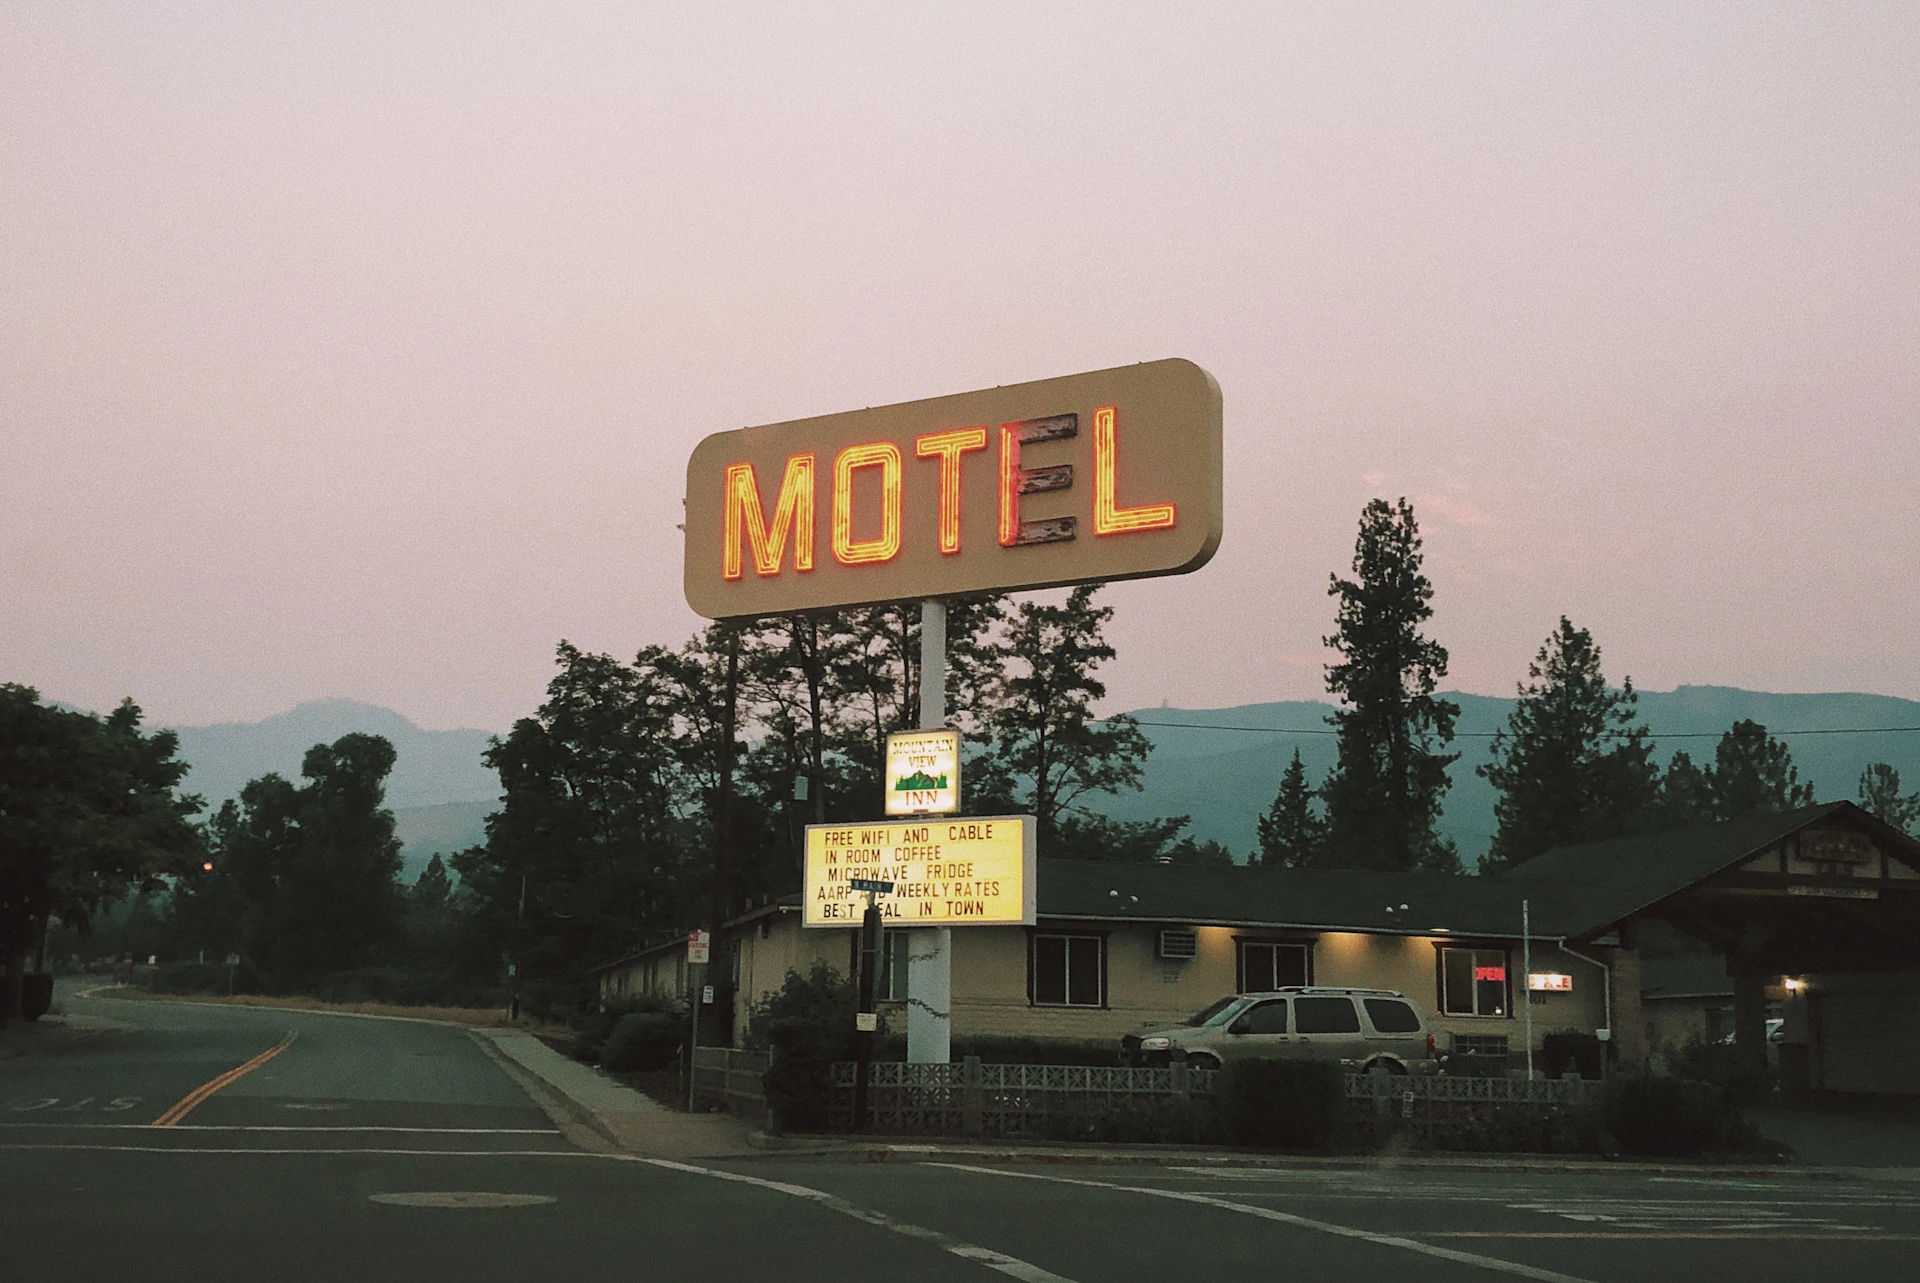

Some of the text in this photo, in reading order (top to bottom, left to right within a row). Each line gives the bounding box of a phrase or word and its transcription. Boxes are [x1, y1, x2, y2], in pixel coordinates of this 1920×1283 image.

[722, 406, 1176, 580] MOTEL
[893, 739, 953, 754] MOUNTAIN
[908, 755, 937, 767] VIEW
[905, 790, 938, 806] INN
[825, 825, 993, 846] FREE WIFI AND CABLE
[825, 845, 941, 864] IN ROOM COFFEE
[828, 863, 973, 881] MICROWAVE FRIDGE
[817, 886, 852, 900] AARP
[897, 883, 949, 898] WEEKLY
[955, 882, 999, 897] RATES
[823, 901, 984, 918] BEST EAL IN TOWN
